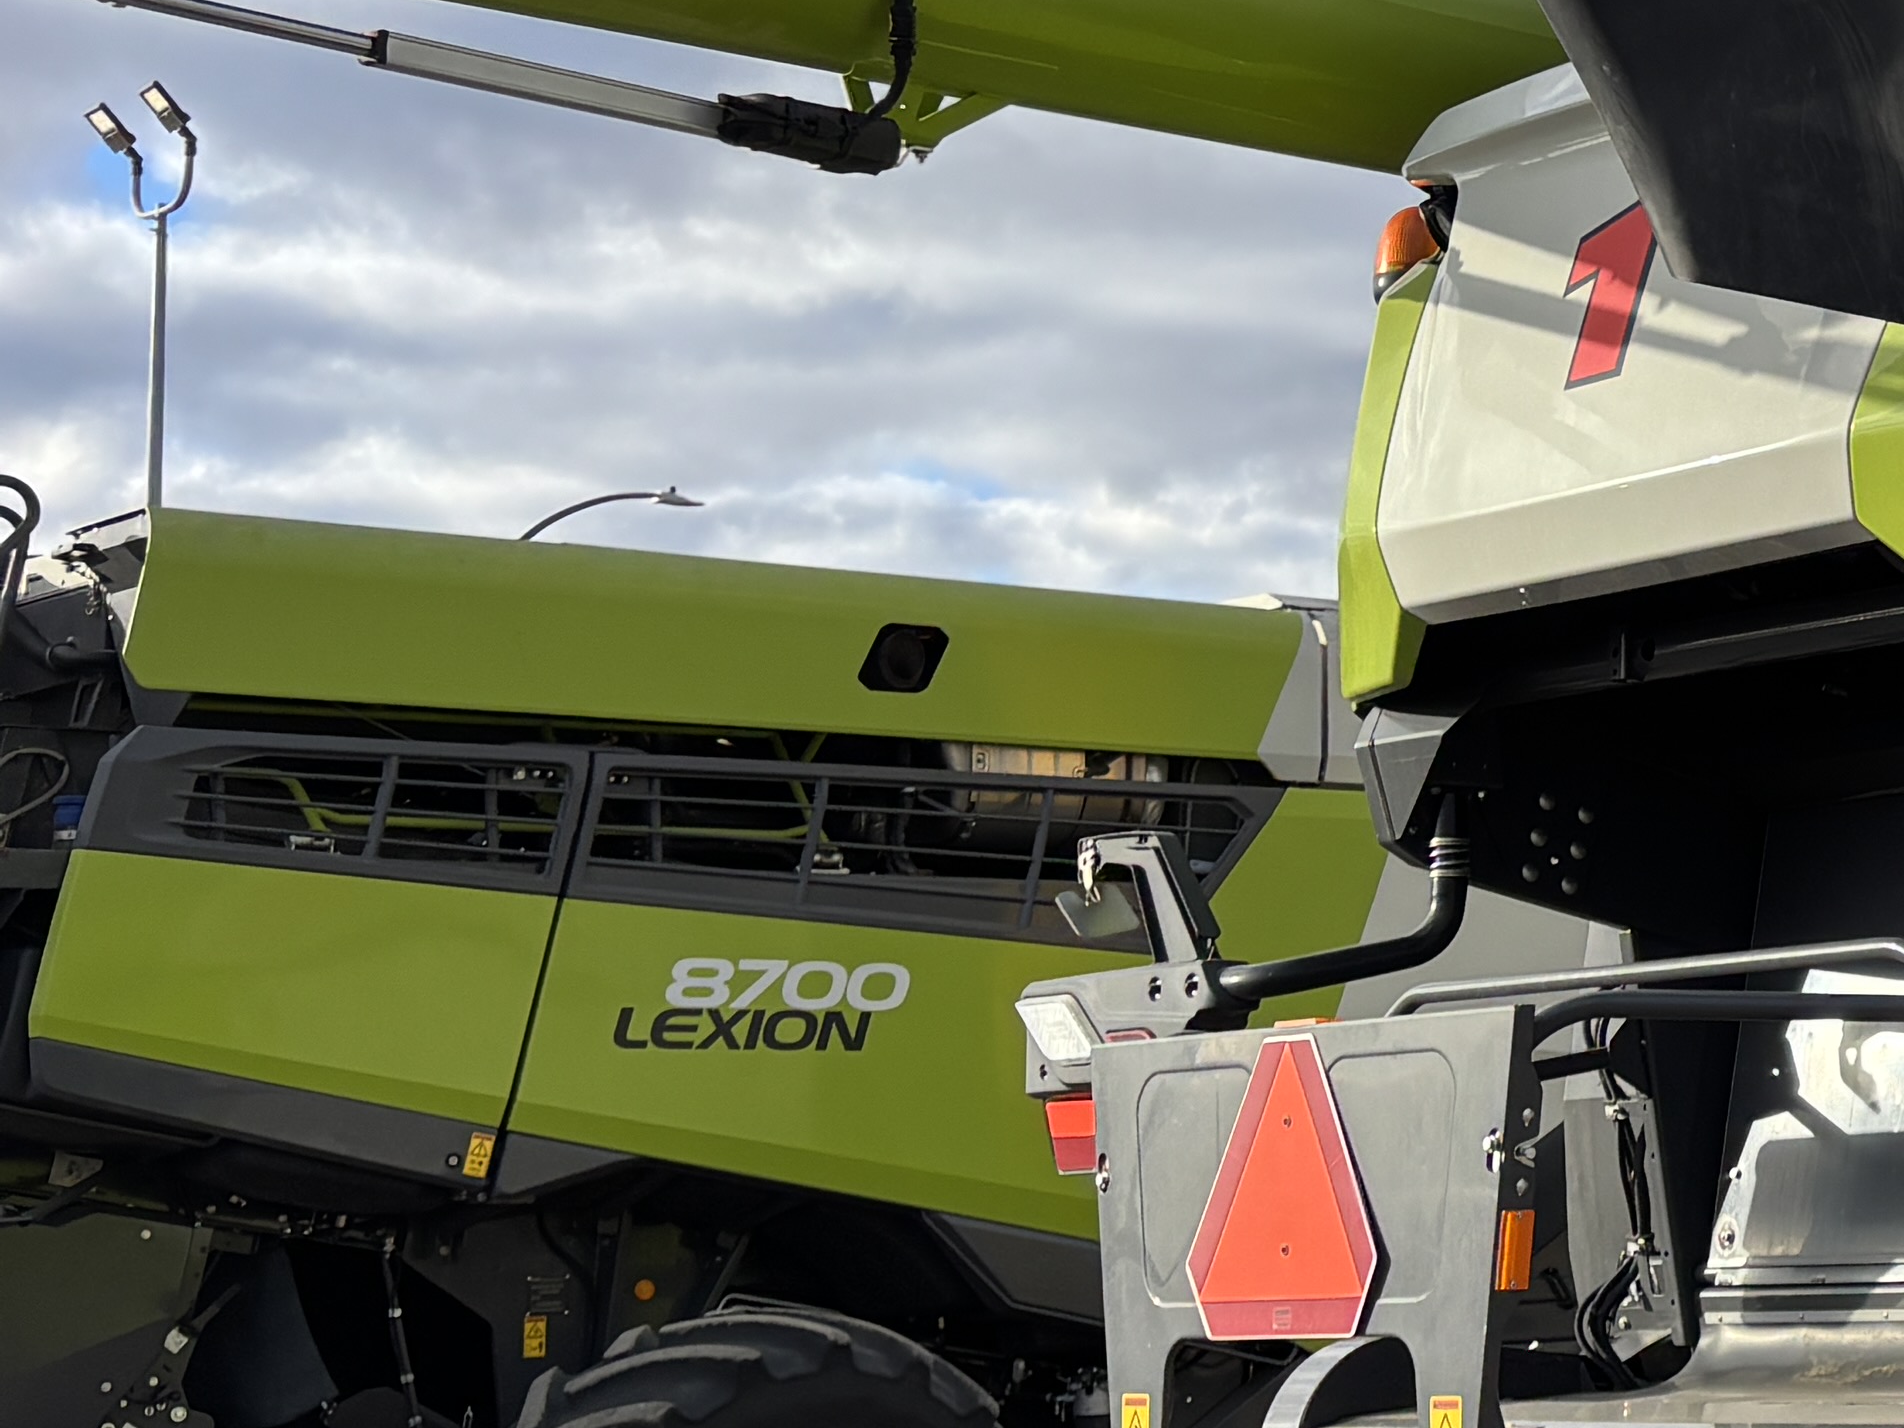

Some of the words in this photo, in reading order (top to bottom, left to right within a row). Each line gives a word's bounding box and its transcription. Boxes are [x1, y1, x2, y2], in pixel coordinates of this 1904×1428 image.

[1563, 199, 1658, 392] 1
[664, 957, 911, 1013] 8700
[612, 1006, 873, 1052] LEXION
